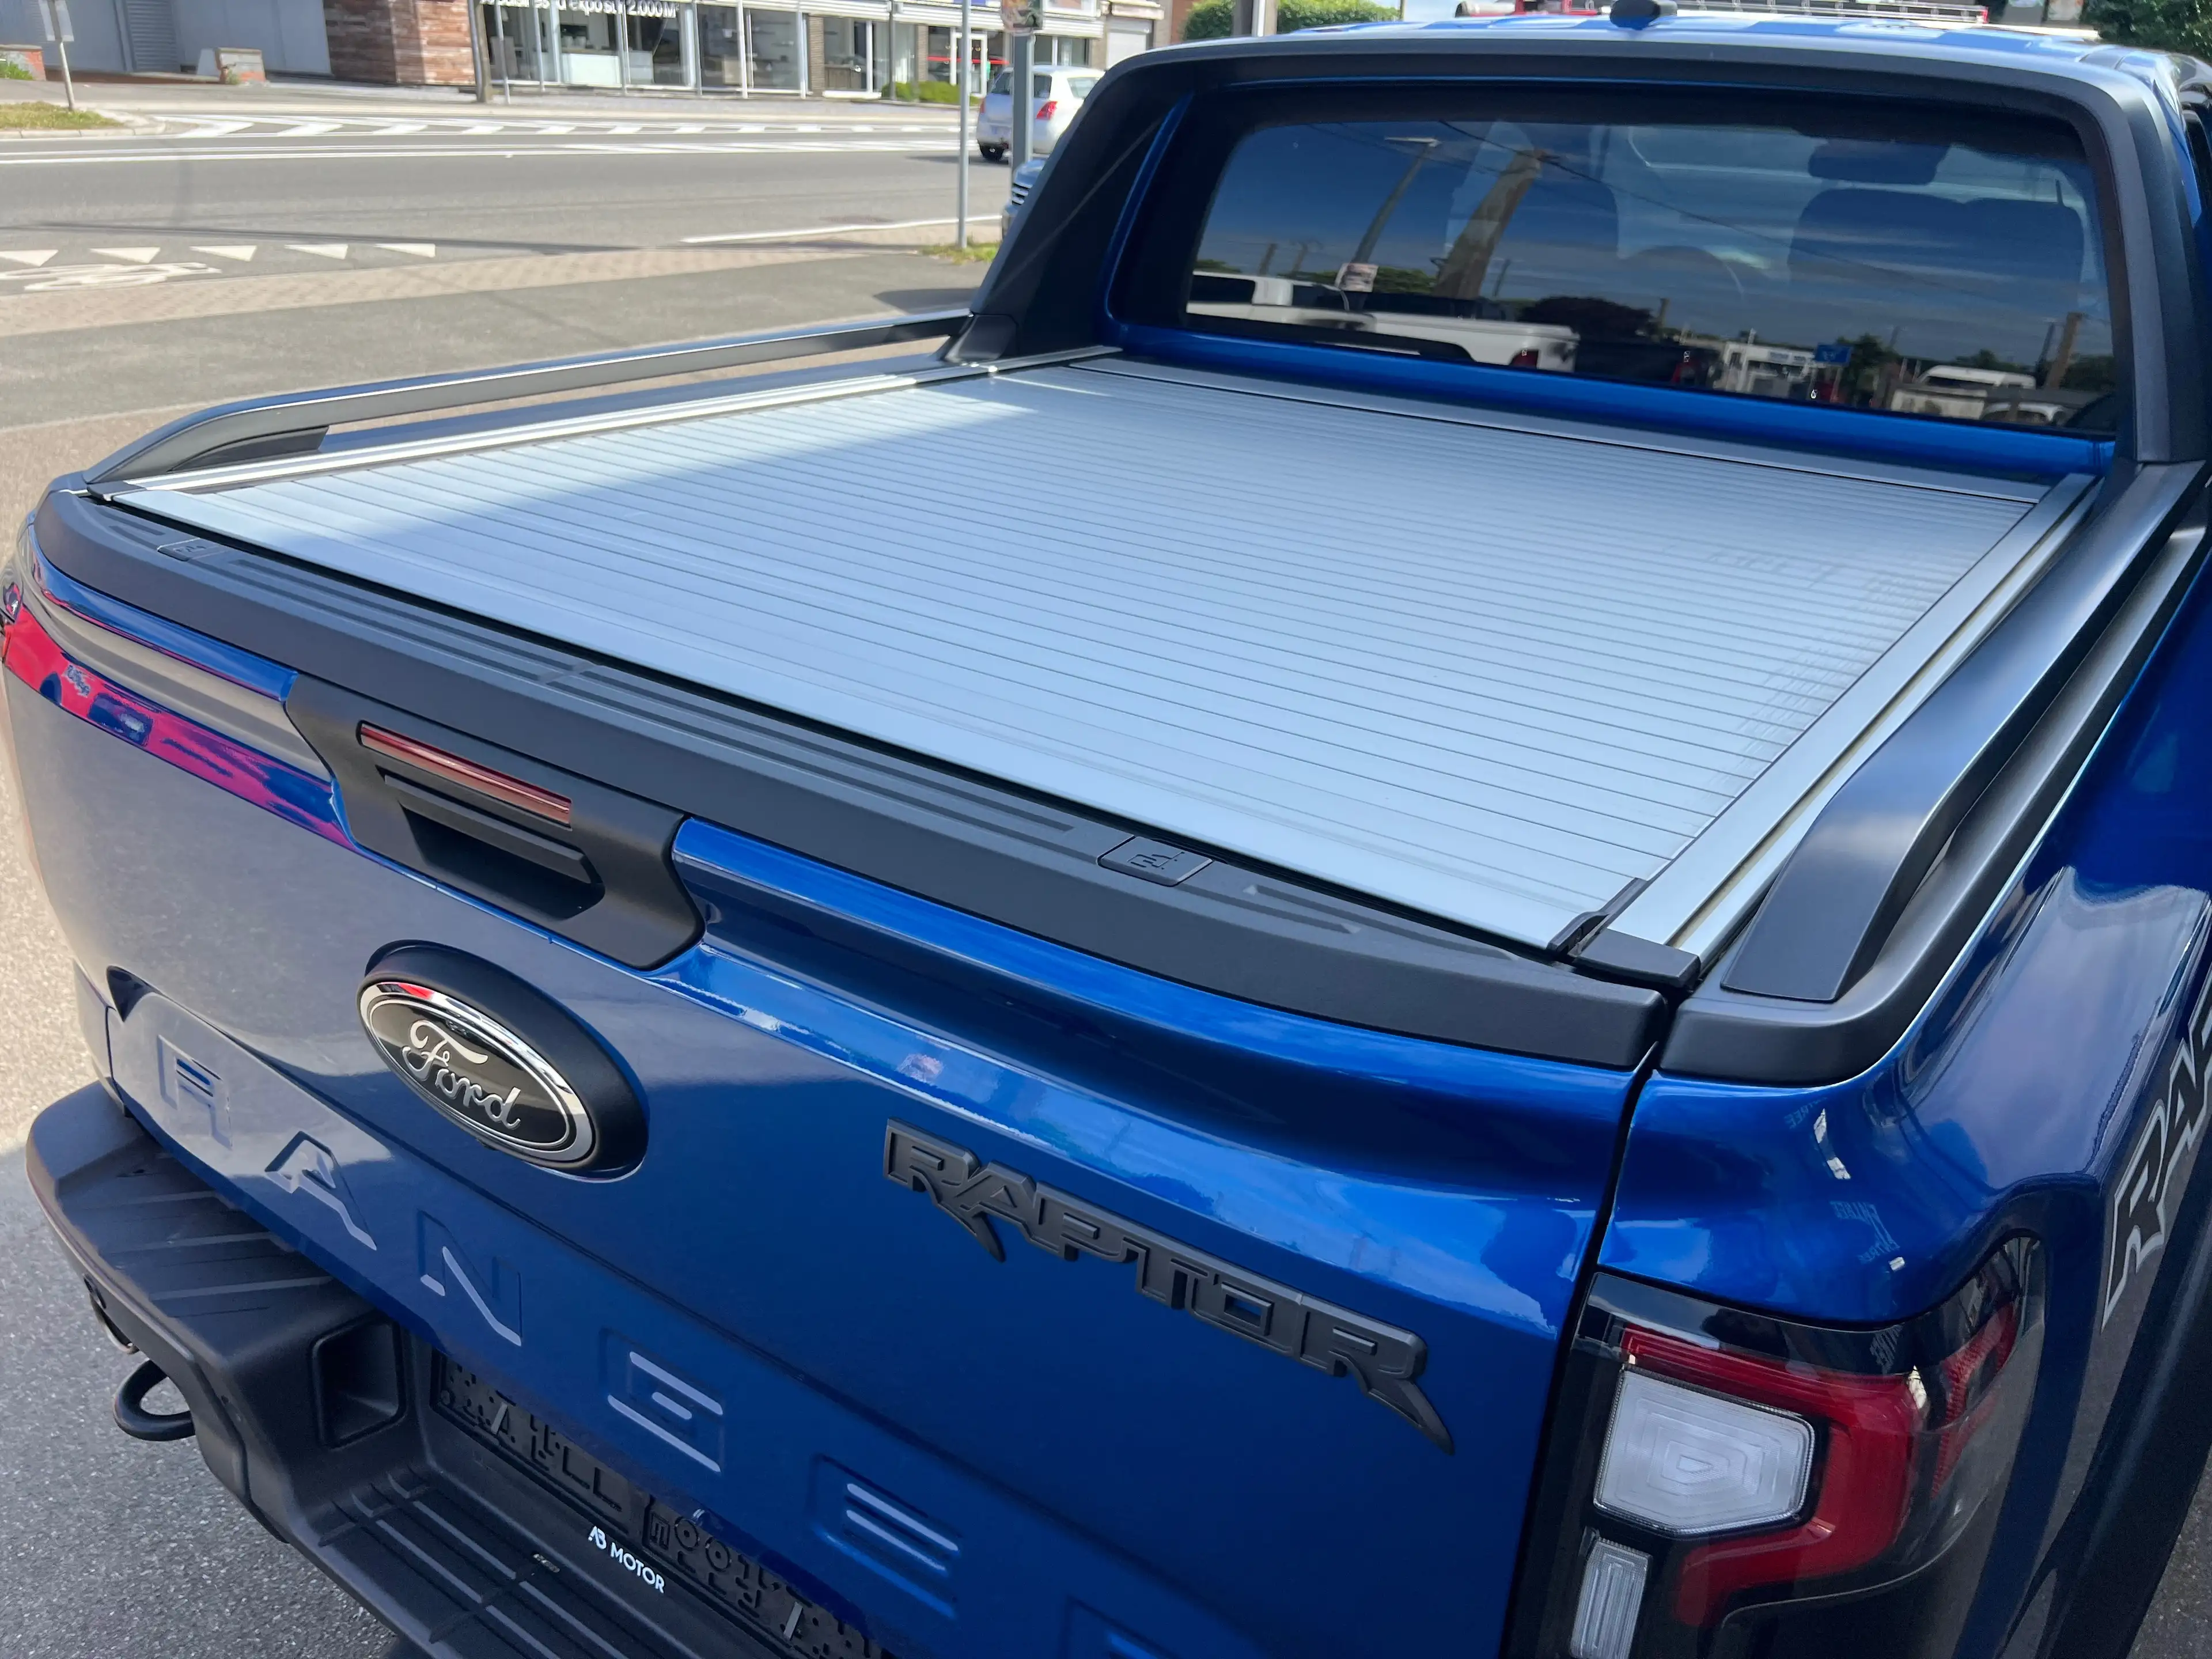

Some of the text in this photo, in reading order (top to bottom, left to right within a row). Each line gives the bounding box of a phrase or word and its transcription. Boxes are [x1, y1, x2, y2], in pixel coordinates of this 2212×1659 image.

[402, 1020, 522, 1130] Ford
[883, 1116, 1455, 1456] RAPTOR
[611, 1542, 665, 1594] MOTOR
